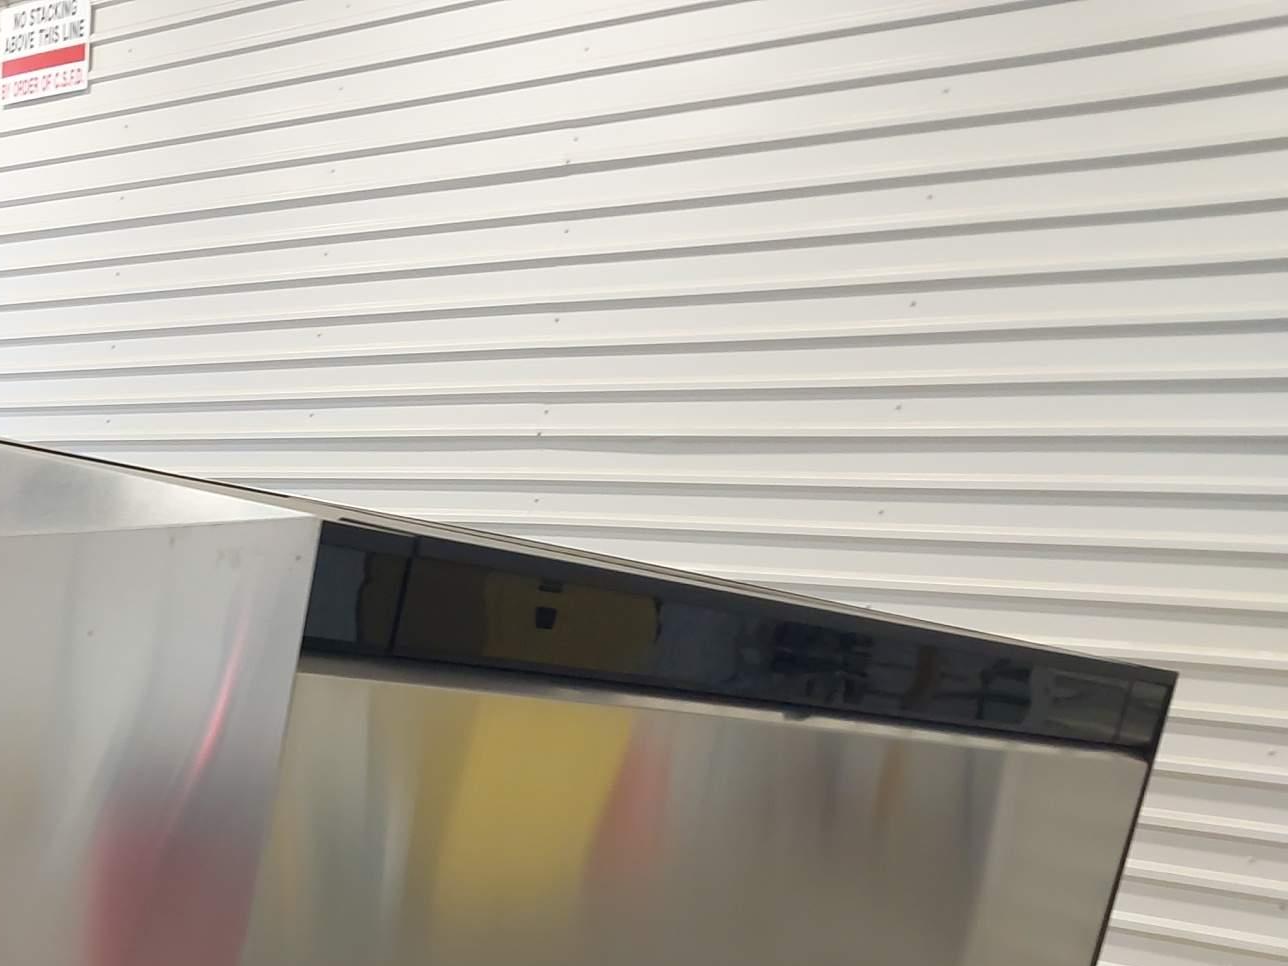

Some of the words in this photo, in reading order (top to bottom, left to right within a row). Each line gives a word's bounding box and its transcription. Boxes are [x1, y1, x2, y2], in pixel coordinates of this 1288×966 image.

[14, 10, 27, 29] NO
[30, 0, 78, 26] STACKING
[5, 30, 34, 53] ABOVE
[38, 25, 60, 46] THIS
[62, 19, 84, 41] LINE
[1, 83, 11, 100] BY
[13, 76, 39, 97] ORDER
[41, 72, 53, 91] OF
